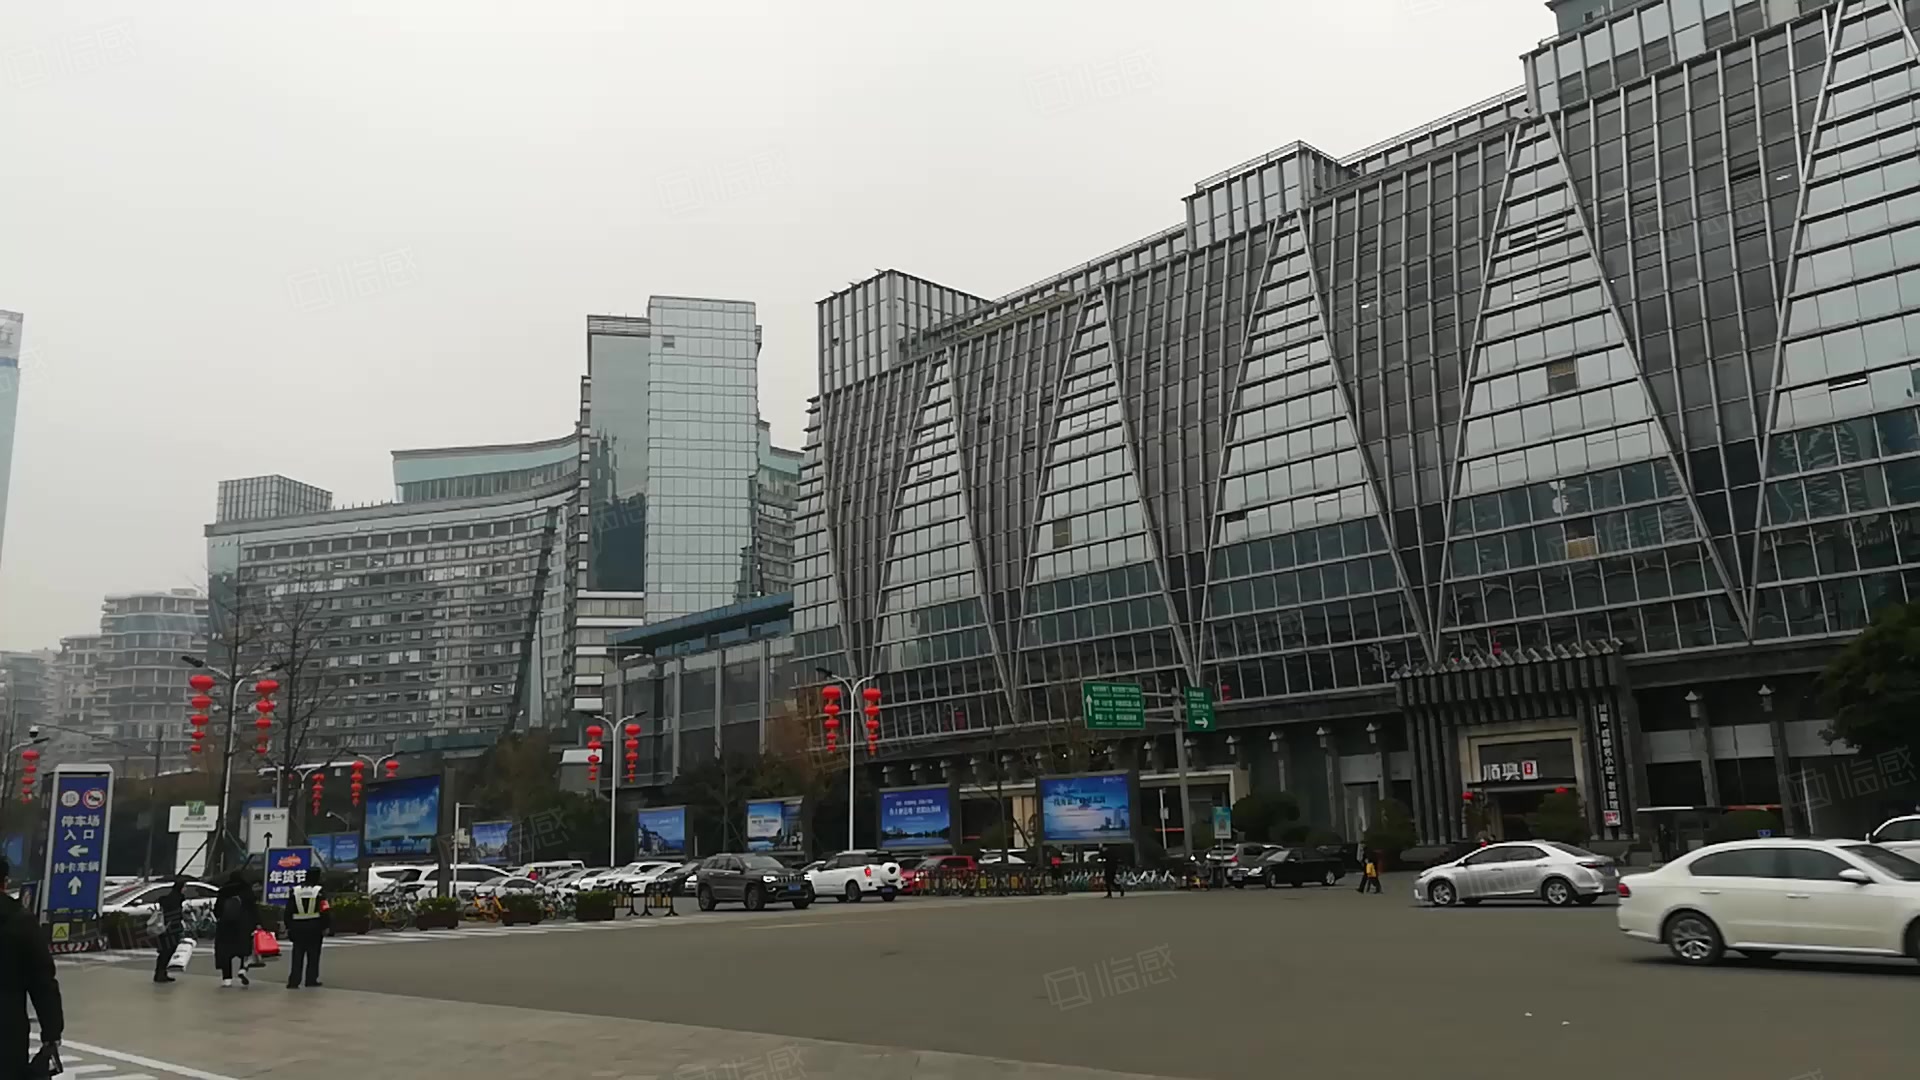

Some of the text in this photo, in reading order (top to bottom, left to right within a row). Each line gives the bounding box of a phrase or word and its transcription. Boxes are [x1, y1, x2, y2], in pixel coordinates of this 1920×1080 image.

[61, 814, 100, 828] 停车场
[64, 829, 94, 841] 入口
[54, 861, 100, 874] 持卡车辆
[269, 869, 307, 885] 年货节
